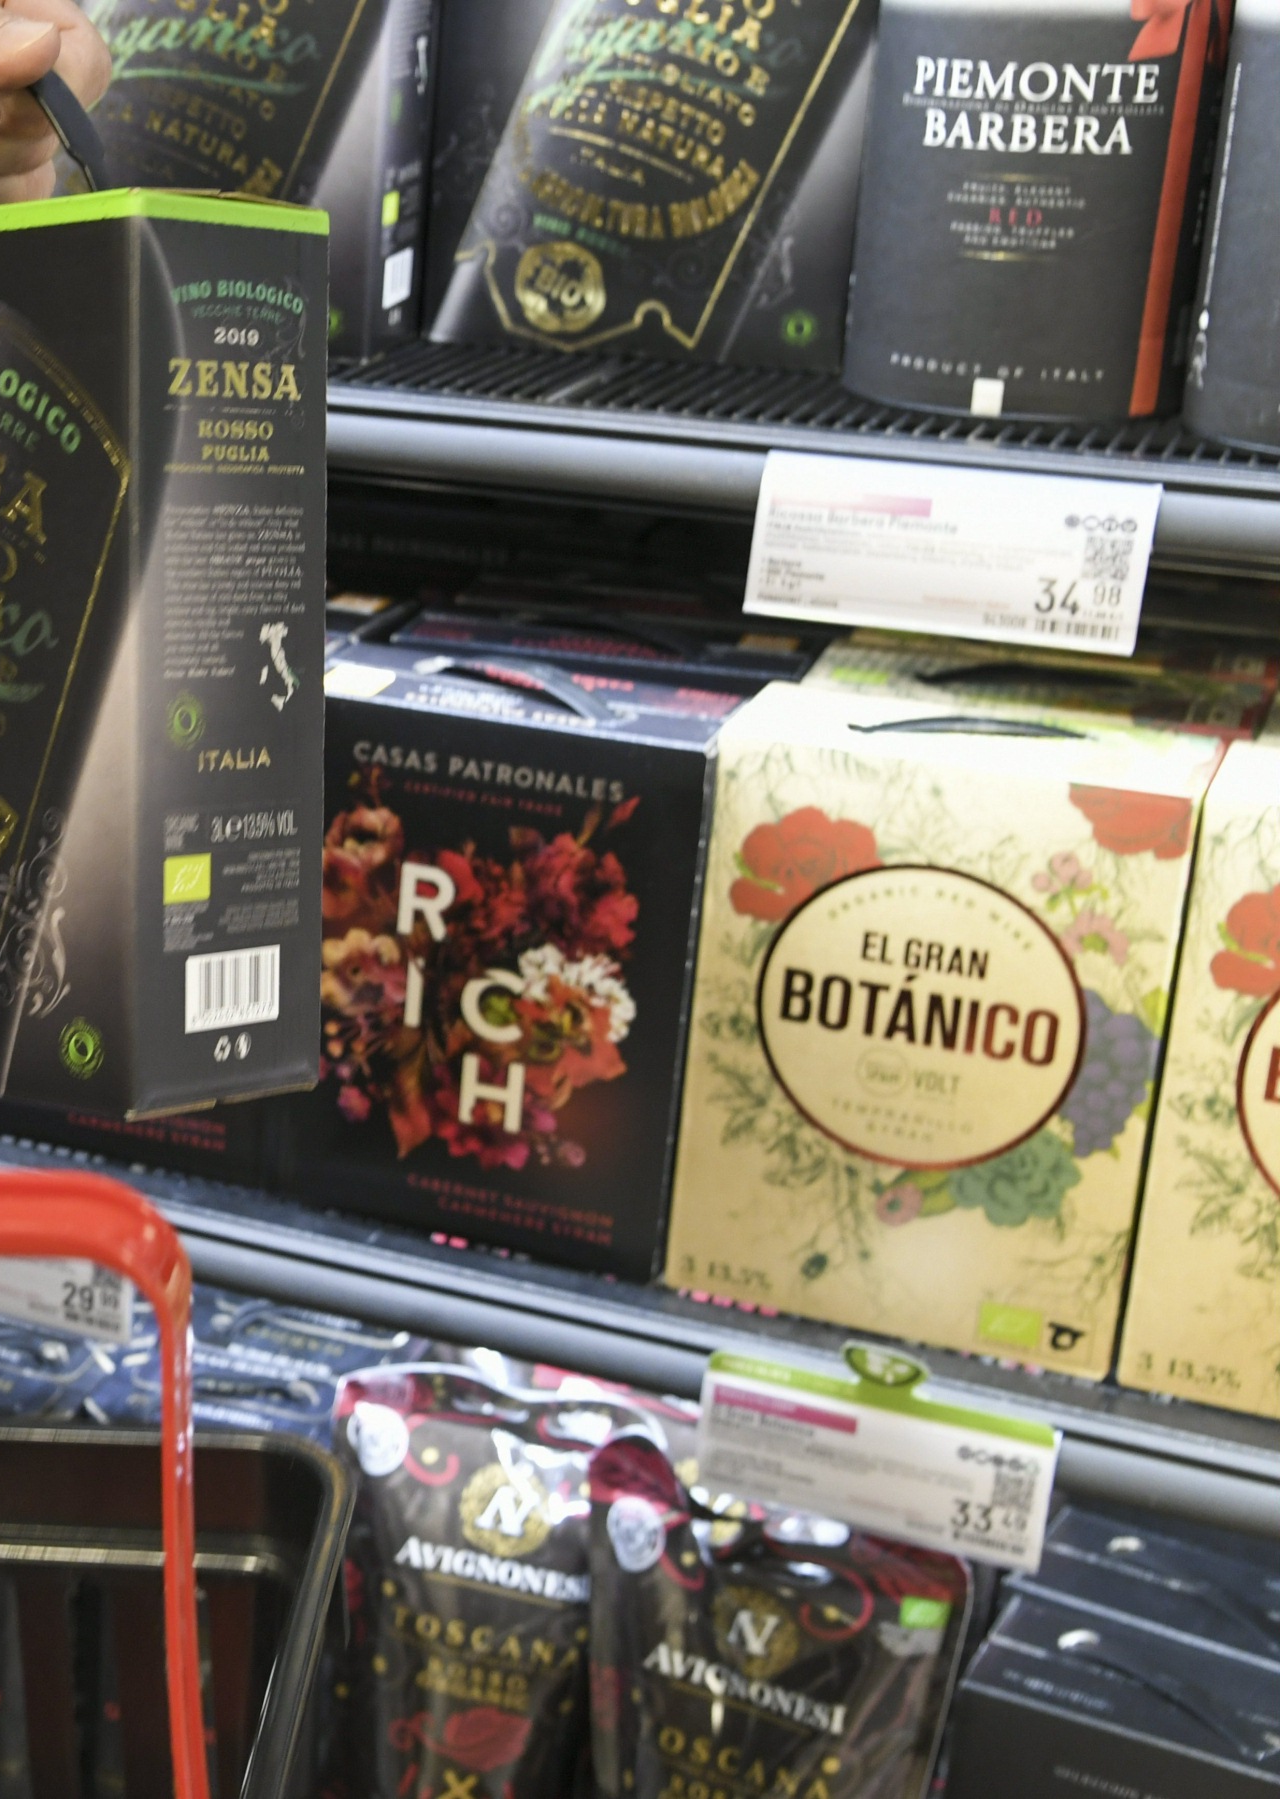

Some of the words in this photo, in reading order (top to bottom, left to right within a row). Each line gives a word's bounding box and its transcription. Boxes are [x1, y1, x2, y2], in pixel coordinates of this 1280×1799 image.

[913, 55, 1161, 104] PIEMONTE
[922, 107, 1133, 155] BARBERA
[171, 280, 212, 304] VINO
[216, 279, 304, 315] BIOLOGICO
[214, 326, 260, 347] 2019
[167, 357, 302, 402] ZENSA
[889, 352, 983, 378] PRODUCT
[997, 364, 1024, 380] OF
[1040, 367, 1107, 384] ITALY
[197, 418, 274, 441] ROSSO
[201, 444, 270, 462] PUGLIA
[1034, 577, 1080, 615] 34
[197, 746, 271, 773] ITALIA
[352, 740, 440, 774] CASAS
[447, 754, 625, 802] PATRONALES
[860, 931, 893, 966] EL
[903, 938, 990, 980] GRAN
[779, 967, 1060, 1067] BOTÁNICO
[62, 1281, 95, 1312] 29
[951, 1497, 992, 1532] 33
[727, 1609, 781, 1656] N
[642, 1641, 847, 1735] AVIGNONESI
[658, 1727, 830, 1799] OSCANA
